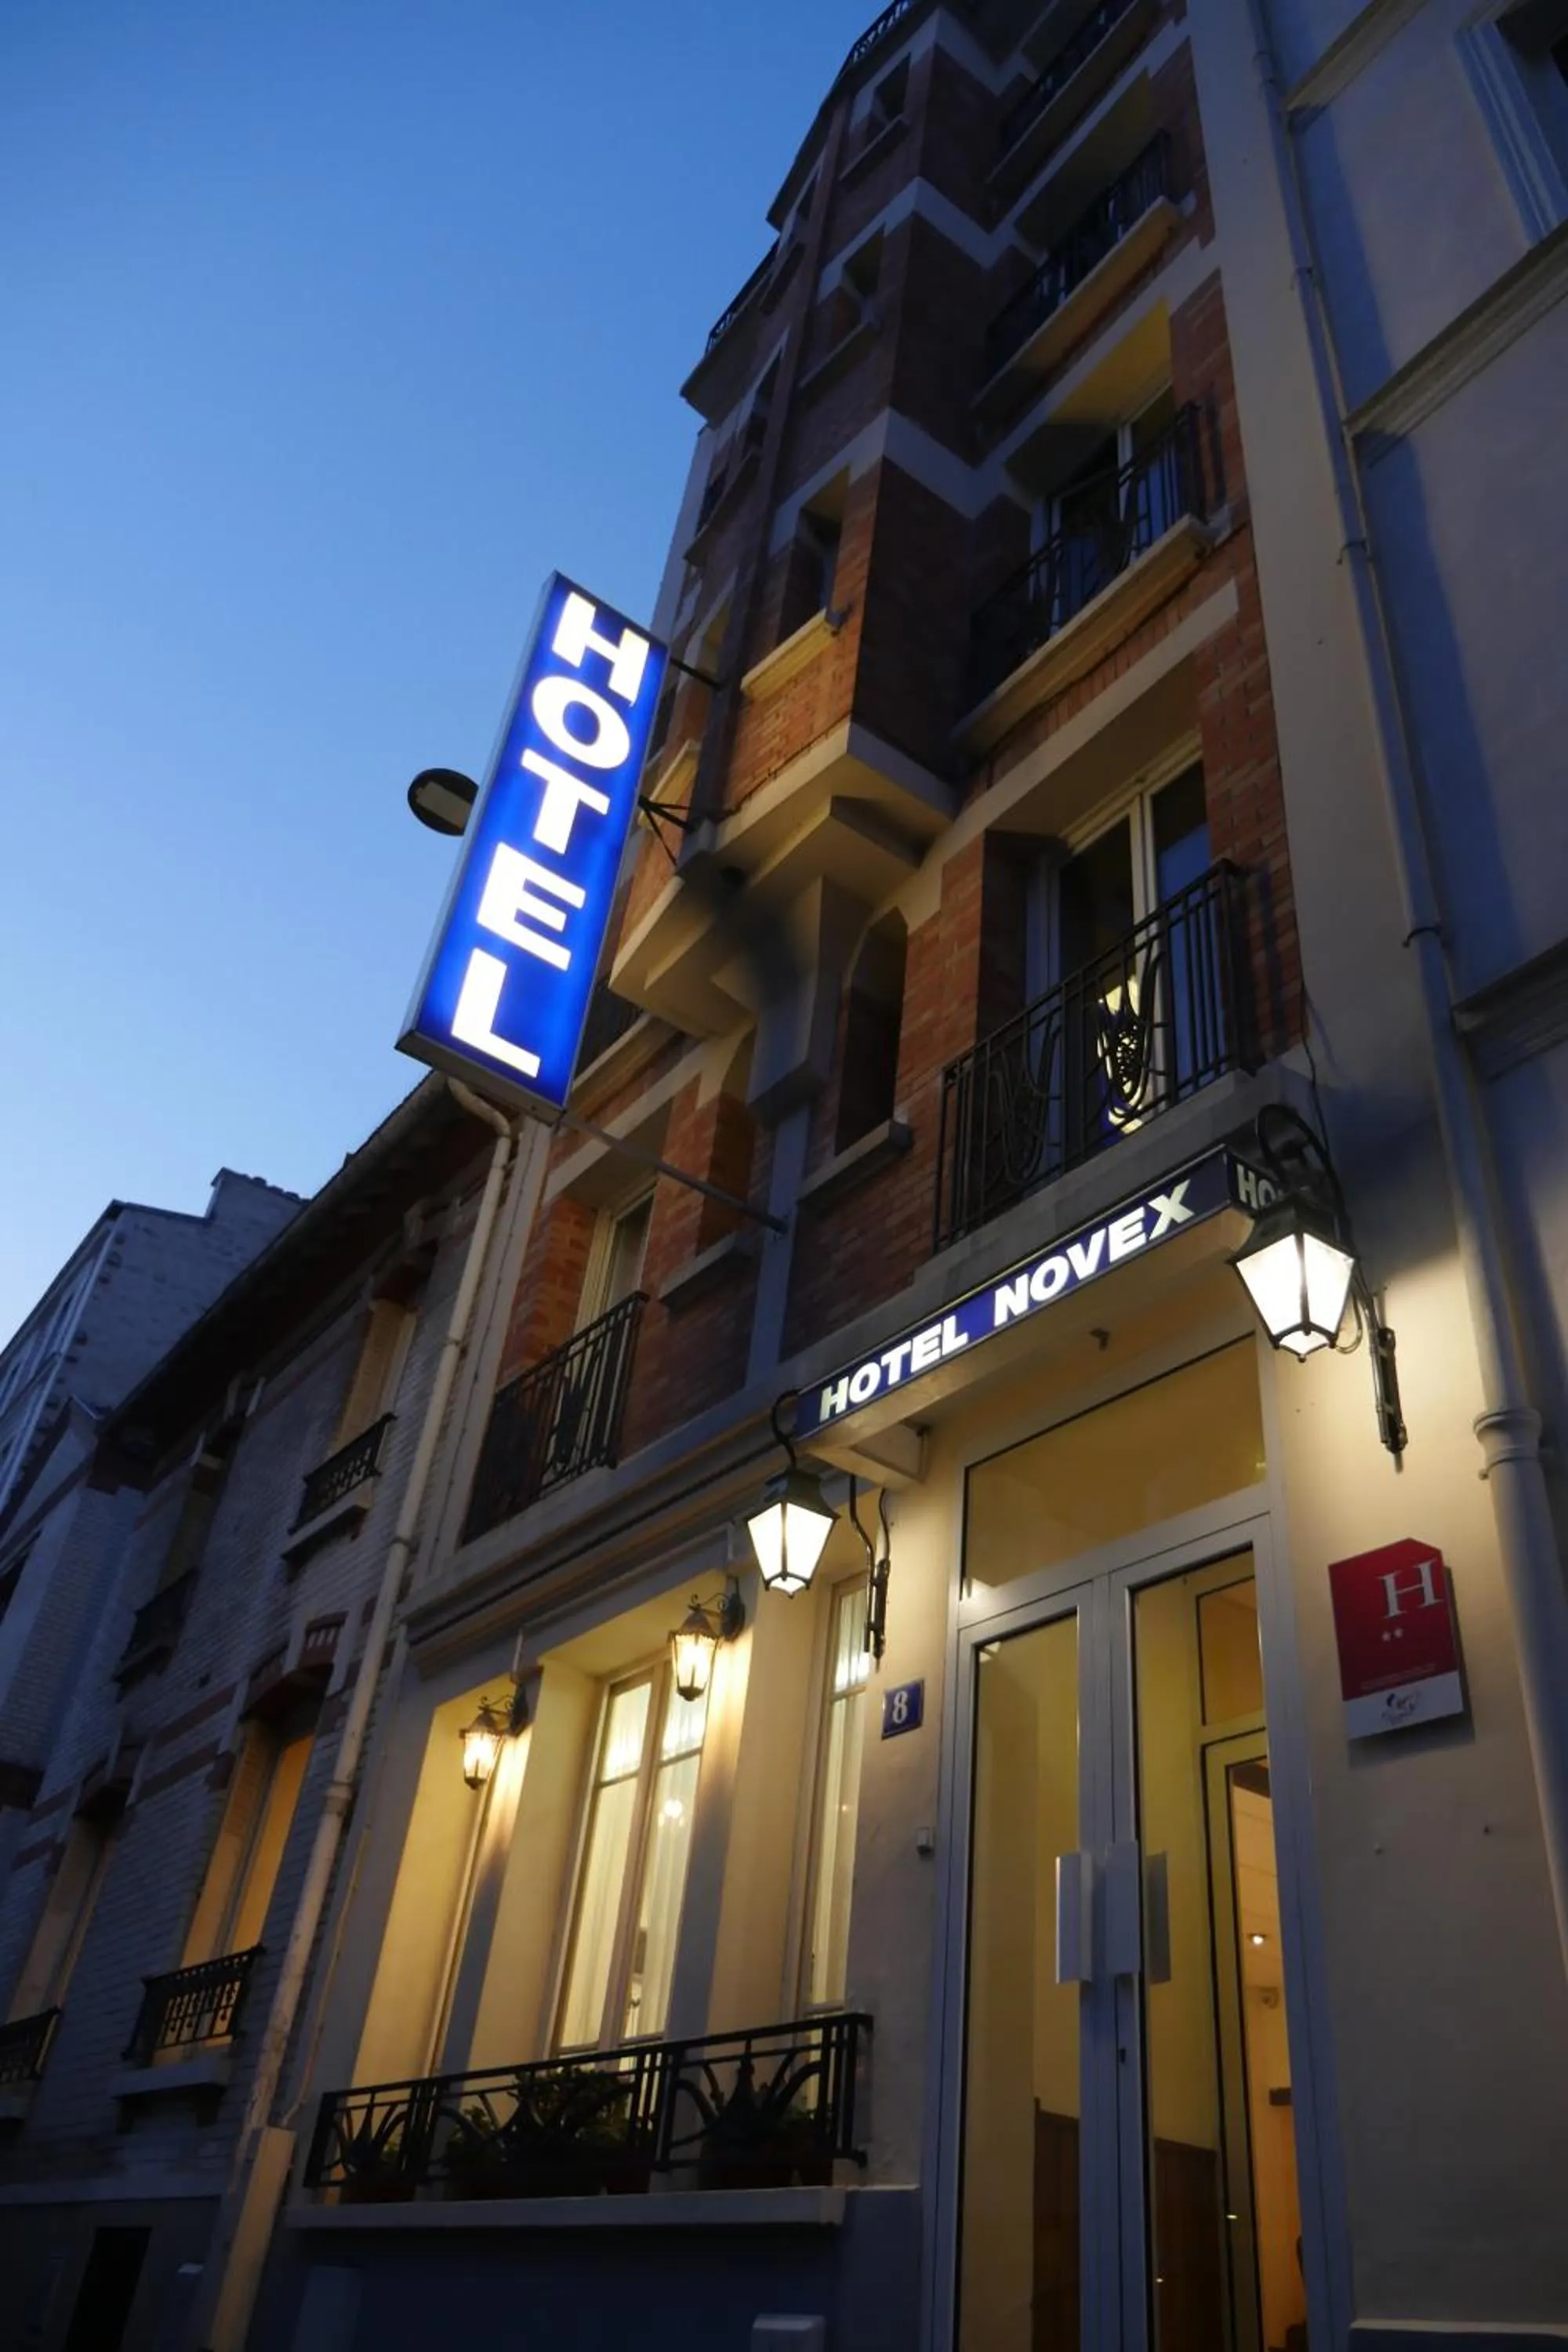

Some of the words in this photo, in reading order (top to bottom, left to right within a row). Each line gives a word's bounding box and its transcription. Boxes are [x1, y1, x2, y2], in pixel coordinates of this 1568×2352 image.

[450, 591, 650, 1078] HOTEL
[1236, 1163, 1286, 1210] HO
[819, 1315, 969, 1421] HOTEL
[993, 1179, 1195, 1327] NOVEX
[1377, 1558, 1444, 1619] H
[892, 1690, 909, 1724] 8
